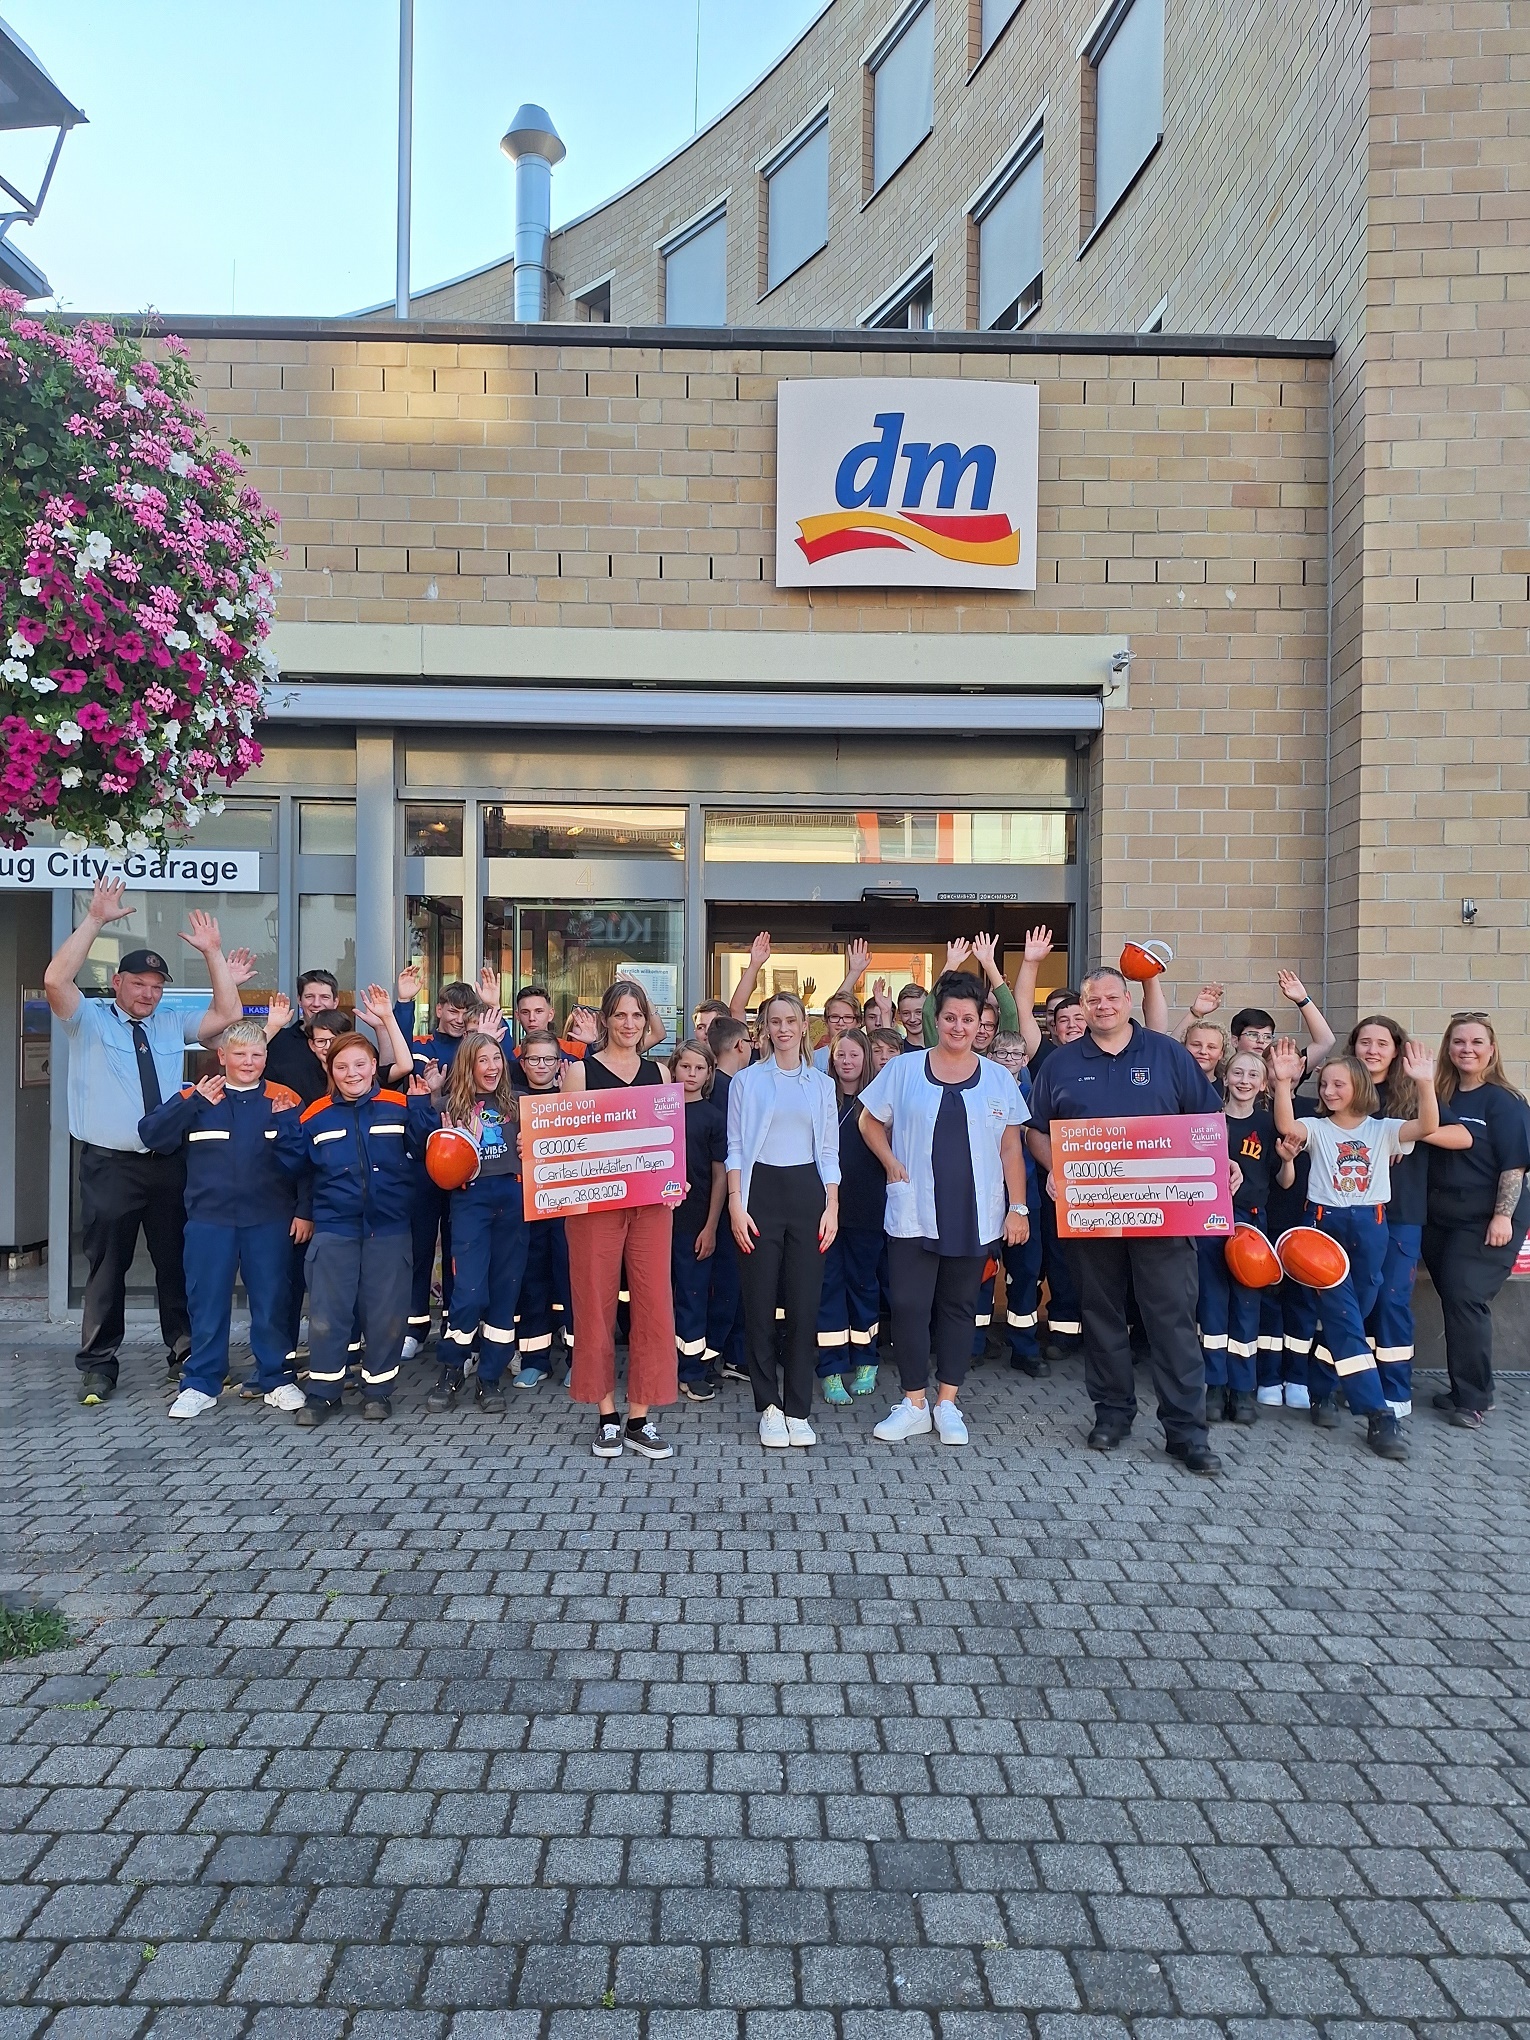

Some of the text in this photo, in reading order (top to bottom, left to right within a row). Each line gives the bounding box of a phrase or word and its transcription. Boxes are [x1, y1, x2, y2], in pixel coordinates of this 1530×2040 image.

[835, 412, 997, 510] dm
[0, 852, 238, 886] ug City-Garage
[575, 865, 595, 893] 4
[531, 1099, 596, 1116] Spende von
[654, 1101, 681, 1111] Zukunft
[531, 1107, 637, 1129] dm-drogerie markt
[1060, 1125, 1127, 1140] Spende von
[1191, 1132, 1222, 1141] Zukunft
[484, 1142, 508, 1156] VIBES
[1061, 1136, 1172, 1153] dm-drogerie markt
[1240, 1138, 1263, 1161] 112
[538, 1164, 578, 1182] Caritas
[636, 1155, 665, 1173] Mayen
[666, 1181, 680, 1191] dm
[538, 1184, 624, 1210] Mayen, 28.08.2024
[1067, 1184, 1204, 1207] Jugendfeuerwehr Mayen
[1106, 1211, 1163, 1227] 28.08.2024
[1208, 1215, 1225, 1224] dm
